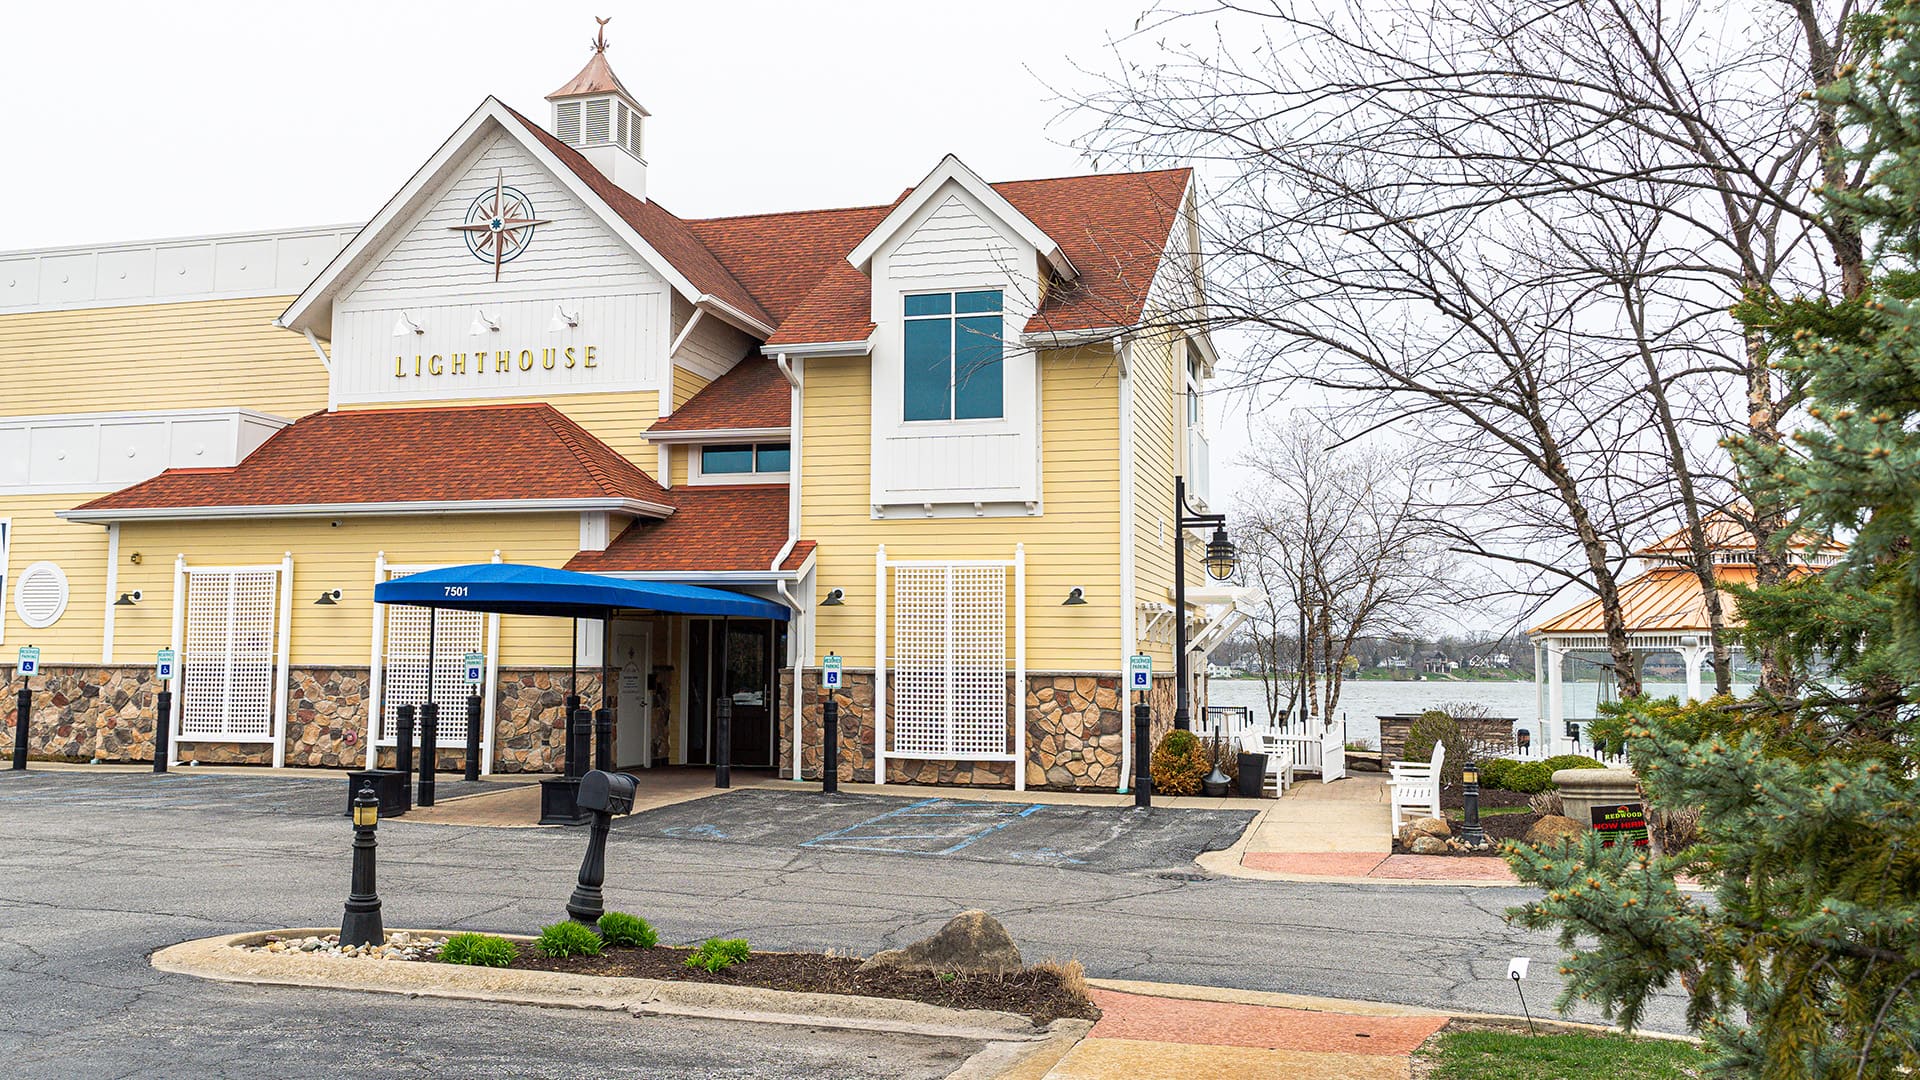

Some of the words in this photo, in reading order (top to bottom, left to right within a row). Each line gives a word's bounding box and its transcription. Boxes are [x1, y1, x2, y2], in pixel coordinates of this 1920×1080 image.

[394, 345, 598, 378] LIGHTHOUSE
[444, 586, 468, 597] 7501
[1605, 811, 1642, 820] REDWOOD
[1593, 822, 1618, 830] NOW
